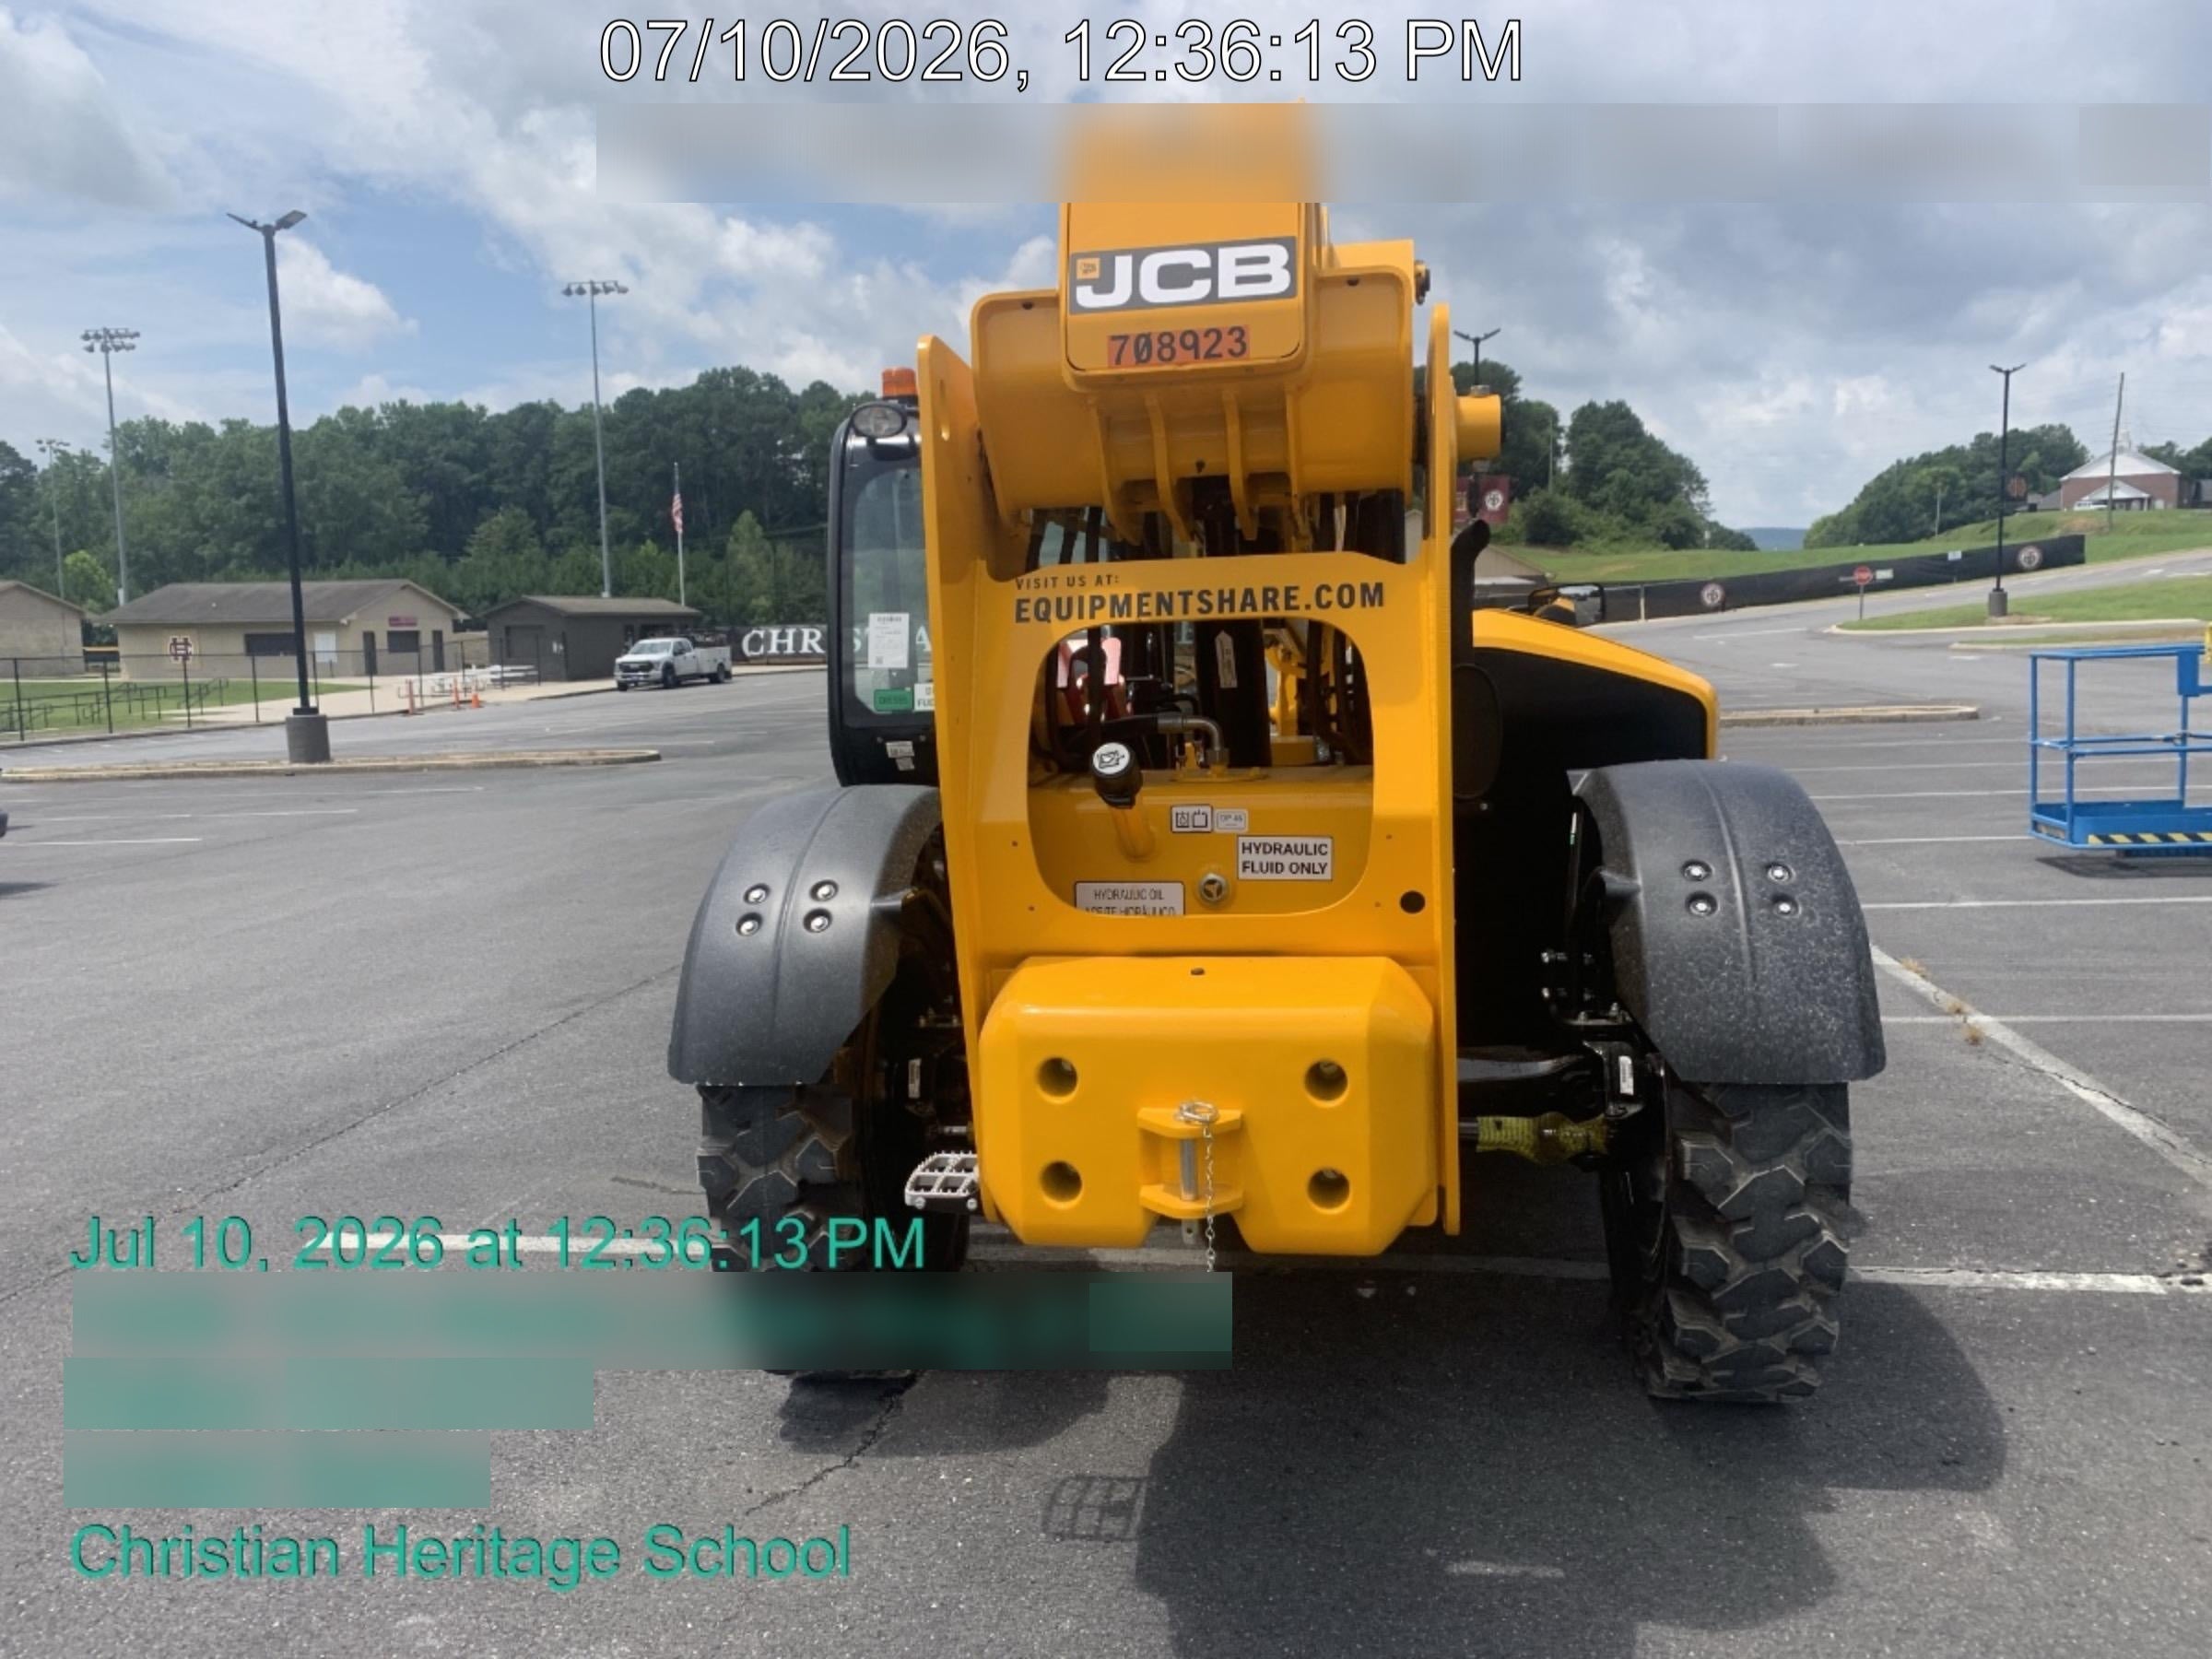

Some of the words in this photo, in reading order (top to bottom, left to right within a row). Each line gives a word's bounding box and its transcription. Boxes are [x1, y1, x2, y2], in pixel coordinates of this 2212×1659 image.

[1076, 243, 1290, 309] JCB
[1110, 325, 1248, 366] 708923
[1016, 575, 1059, 591] VISIT
[1066, 575, 1087, 587] US
[1094, 573, 1120, 586] AT:
[1015, 582, 1384, 624] EQUIPMENTSHARE.COM
[1241, 841, 1328, 856] HYDRAULIC
[1241, 860, 1285, 875] FLUID
[1288, 862, 1328, 876] ONLY
